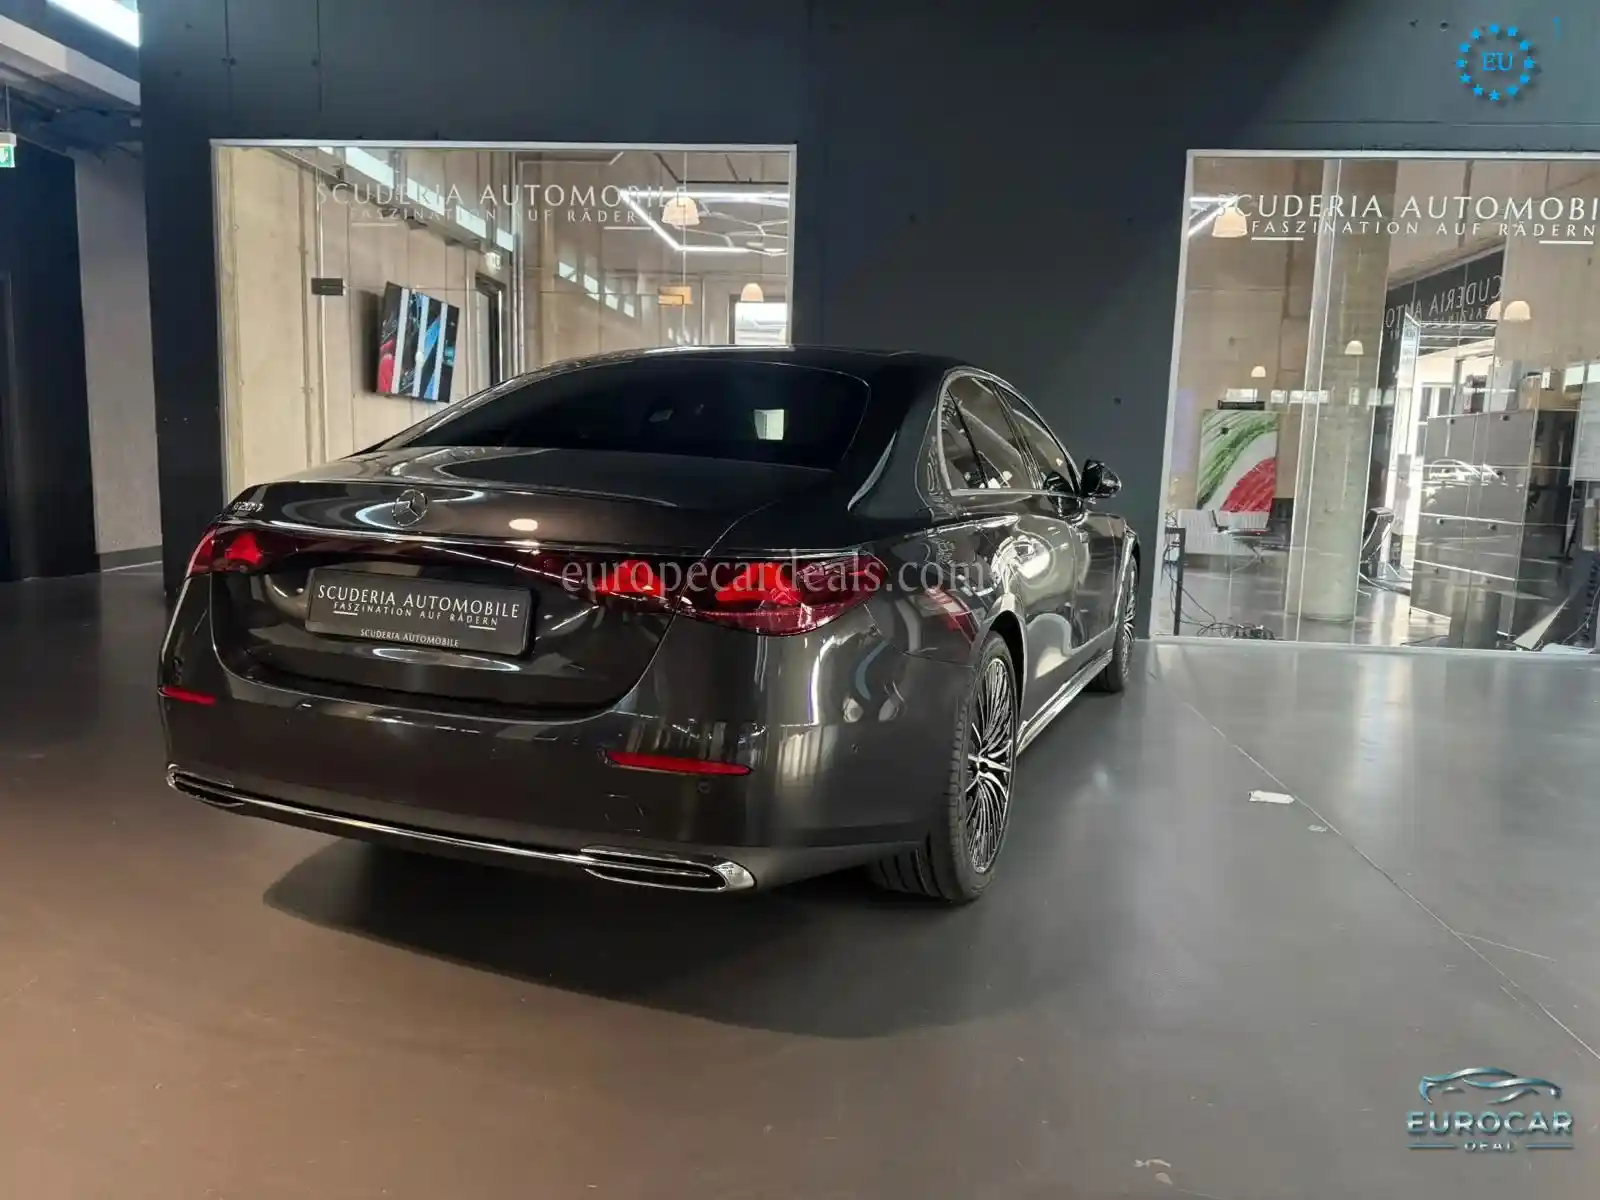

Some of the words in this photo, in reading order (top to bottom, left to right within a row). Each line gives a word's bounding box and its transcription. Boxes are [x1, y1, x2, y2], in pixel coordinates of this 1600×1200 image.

[316, 183, 464, 205] SCUDERIA
[1251, 220, 1419, 235] FASZINATION
[1436, 222, 1481, 236] AUF
[1499, 221, 1596, 237] RÄDERN
[317, 584, 396, 606] SCUDERIA
[402, 593, 520, 619] AUTOMOBILE
[333, 601, 412, 617] FASZINATION
[419, 610, 442, 620] AUF
[360, 628, 400, 641] SCUDERIA
[402, 633, 460, 648] AUTOMOBILE
